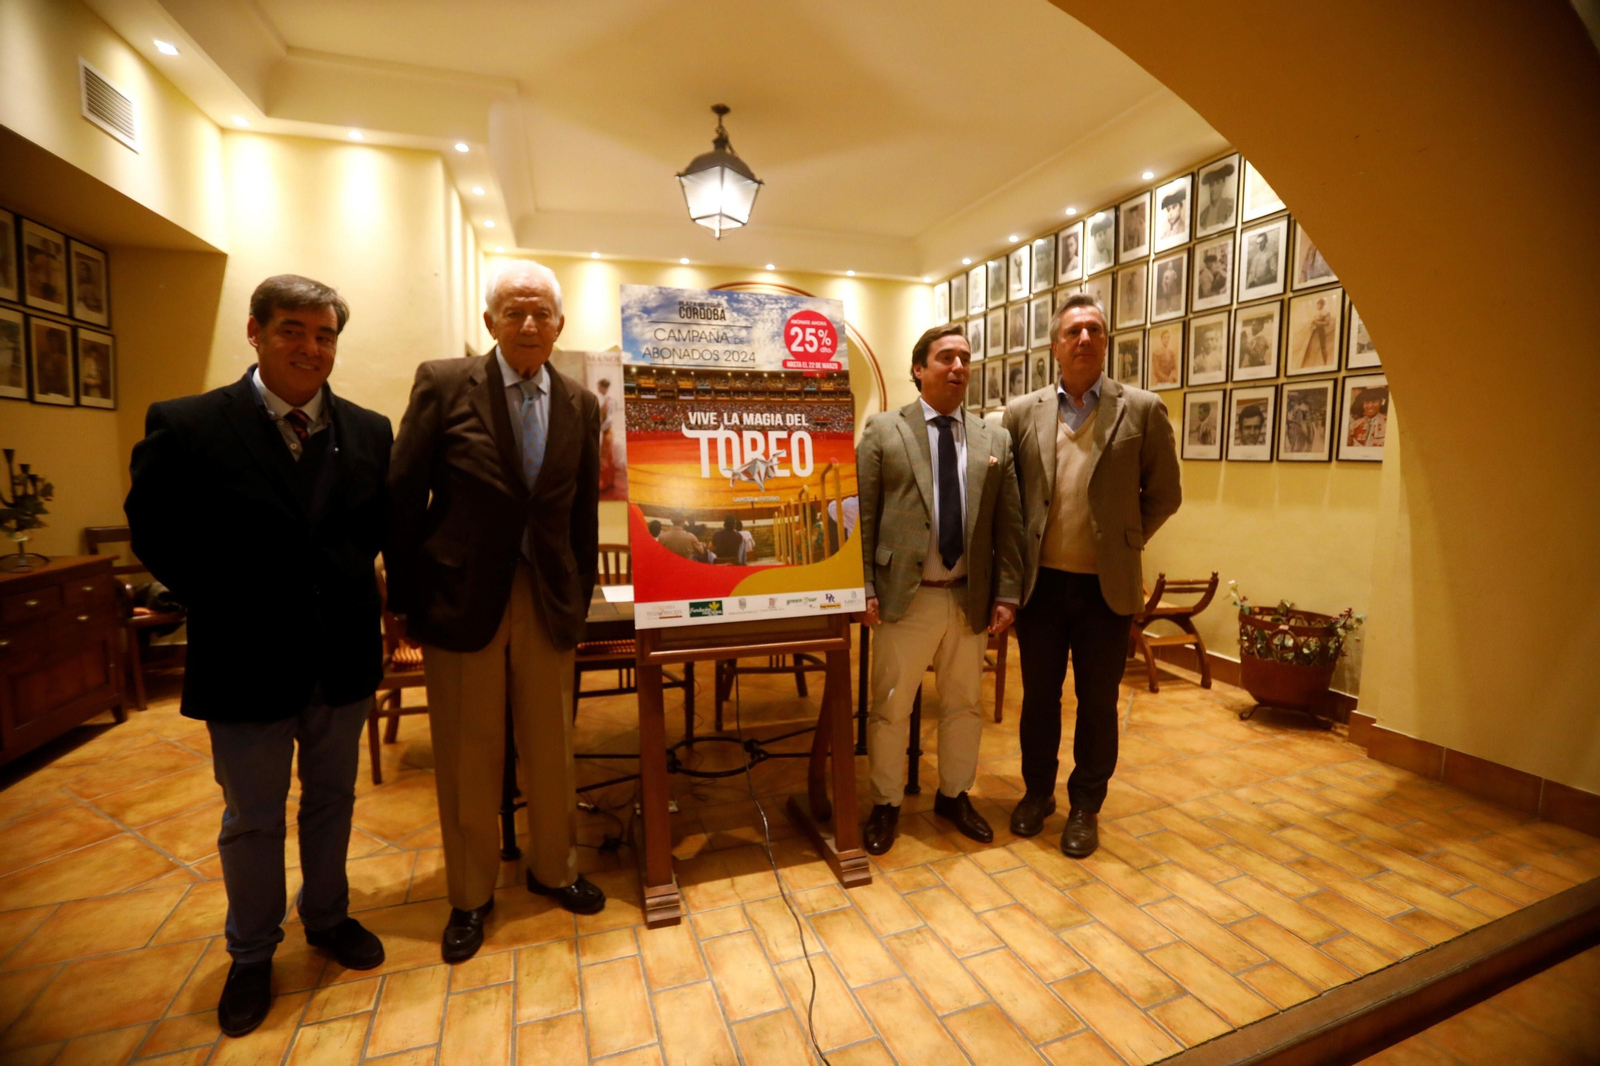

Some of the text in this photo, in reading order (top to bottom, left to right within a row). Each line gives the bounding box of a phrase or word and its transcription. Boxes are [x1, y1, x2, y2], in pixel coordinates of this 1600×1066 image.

[653, 327, 745, 345] CAMPAÑA DE
[790, 326, 832, 353] 25%
[642, 346, 756, 362] ABONADOS 2024
[786, 360, 802, 368] HASTA
[688, 412, 809, 426] VIVE LA MAGIA DEL
[682, 422, 814, 479] TOREO
